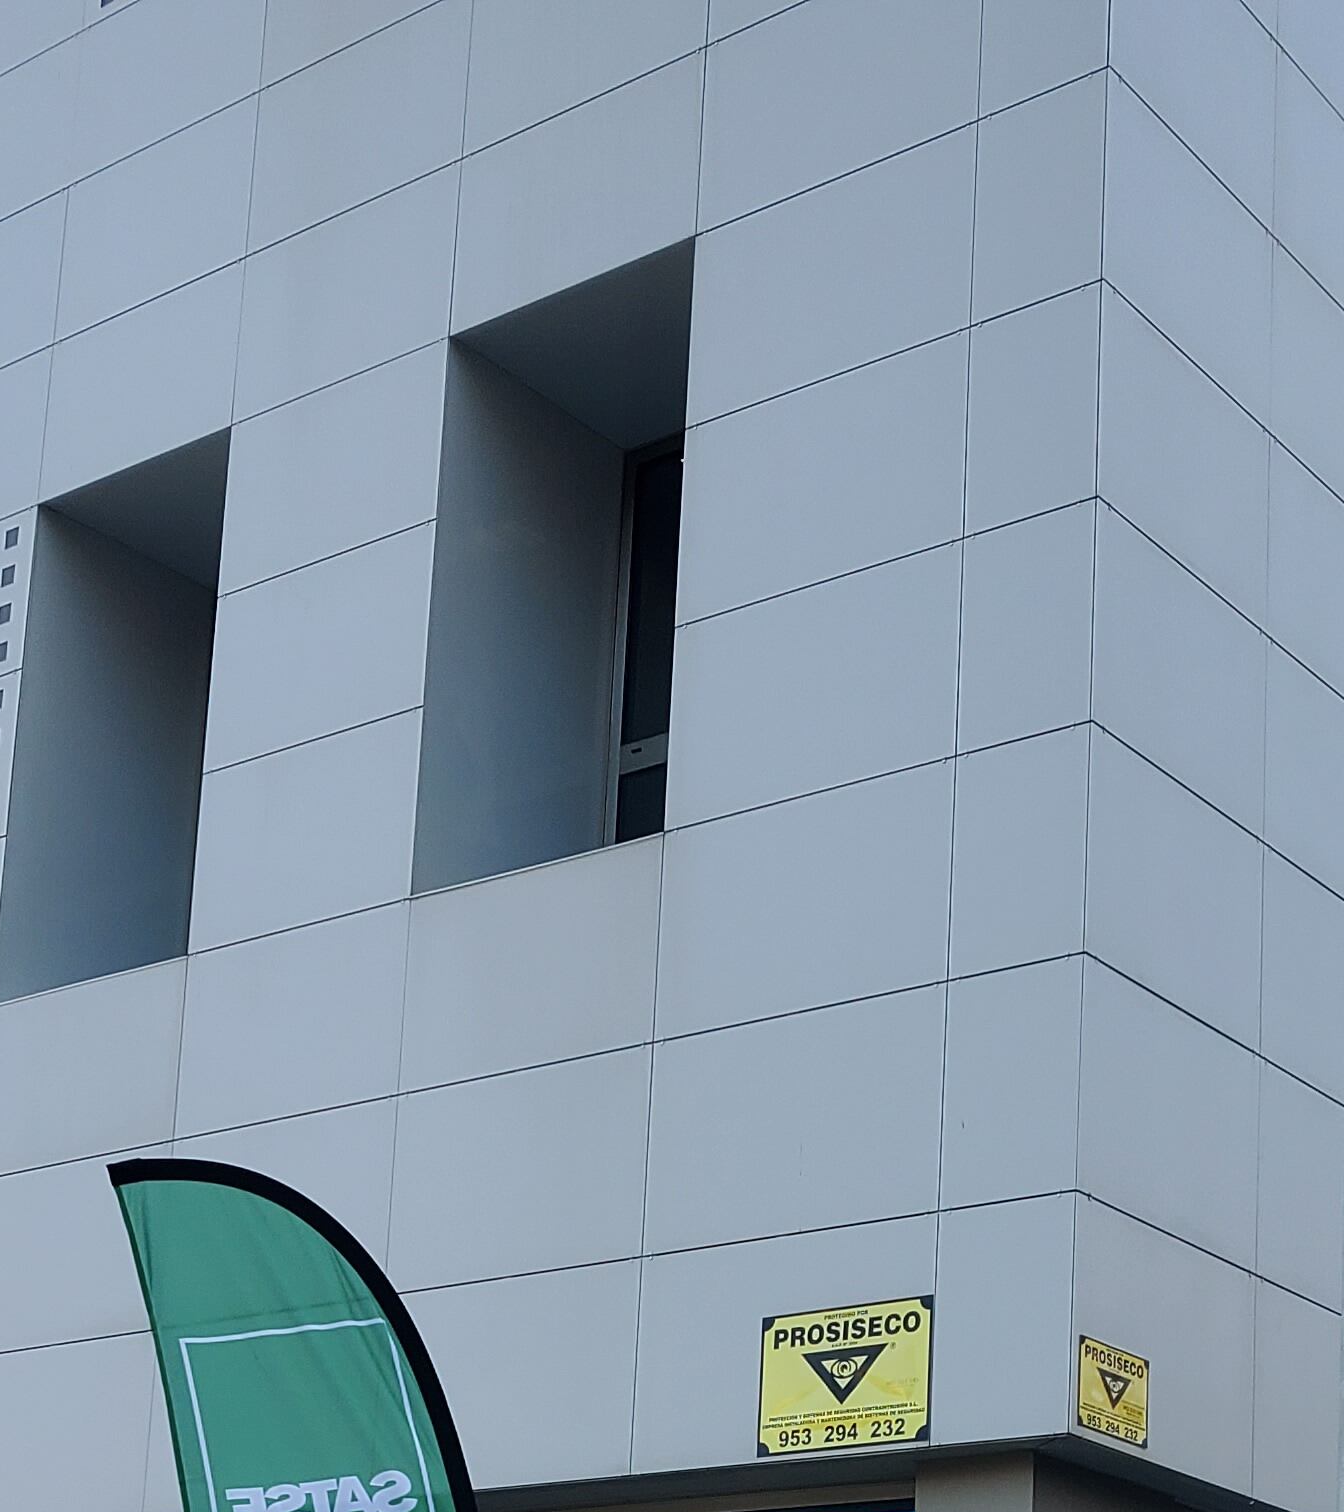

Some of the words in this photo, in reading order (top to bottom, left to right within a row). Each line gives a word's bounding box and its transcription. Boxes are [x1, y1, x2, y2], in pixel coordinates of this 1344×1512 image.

[773, 1310, 921, 1350] PROSISECO
[1084, 1344, 1144, 1379] PROSISECO
[779, 1428, 812, 1448] 953
[824, 1423, 858, 1443] 294
[870, 1418, 905, 1438] 232
[1086, 1413, 1101, 1428] 953
[1105, 1420, 1120, 1434] 294
[1124, 1426, 1138, 1441] 232
